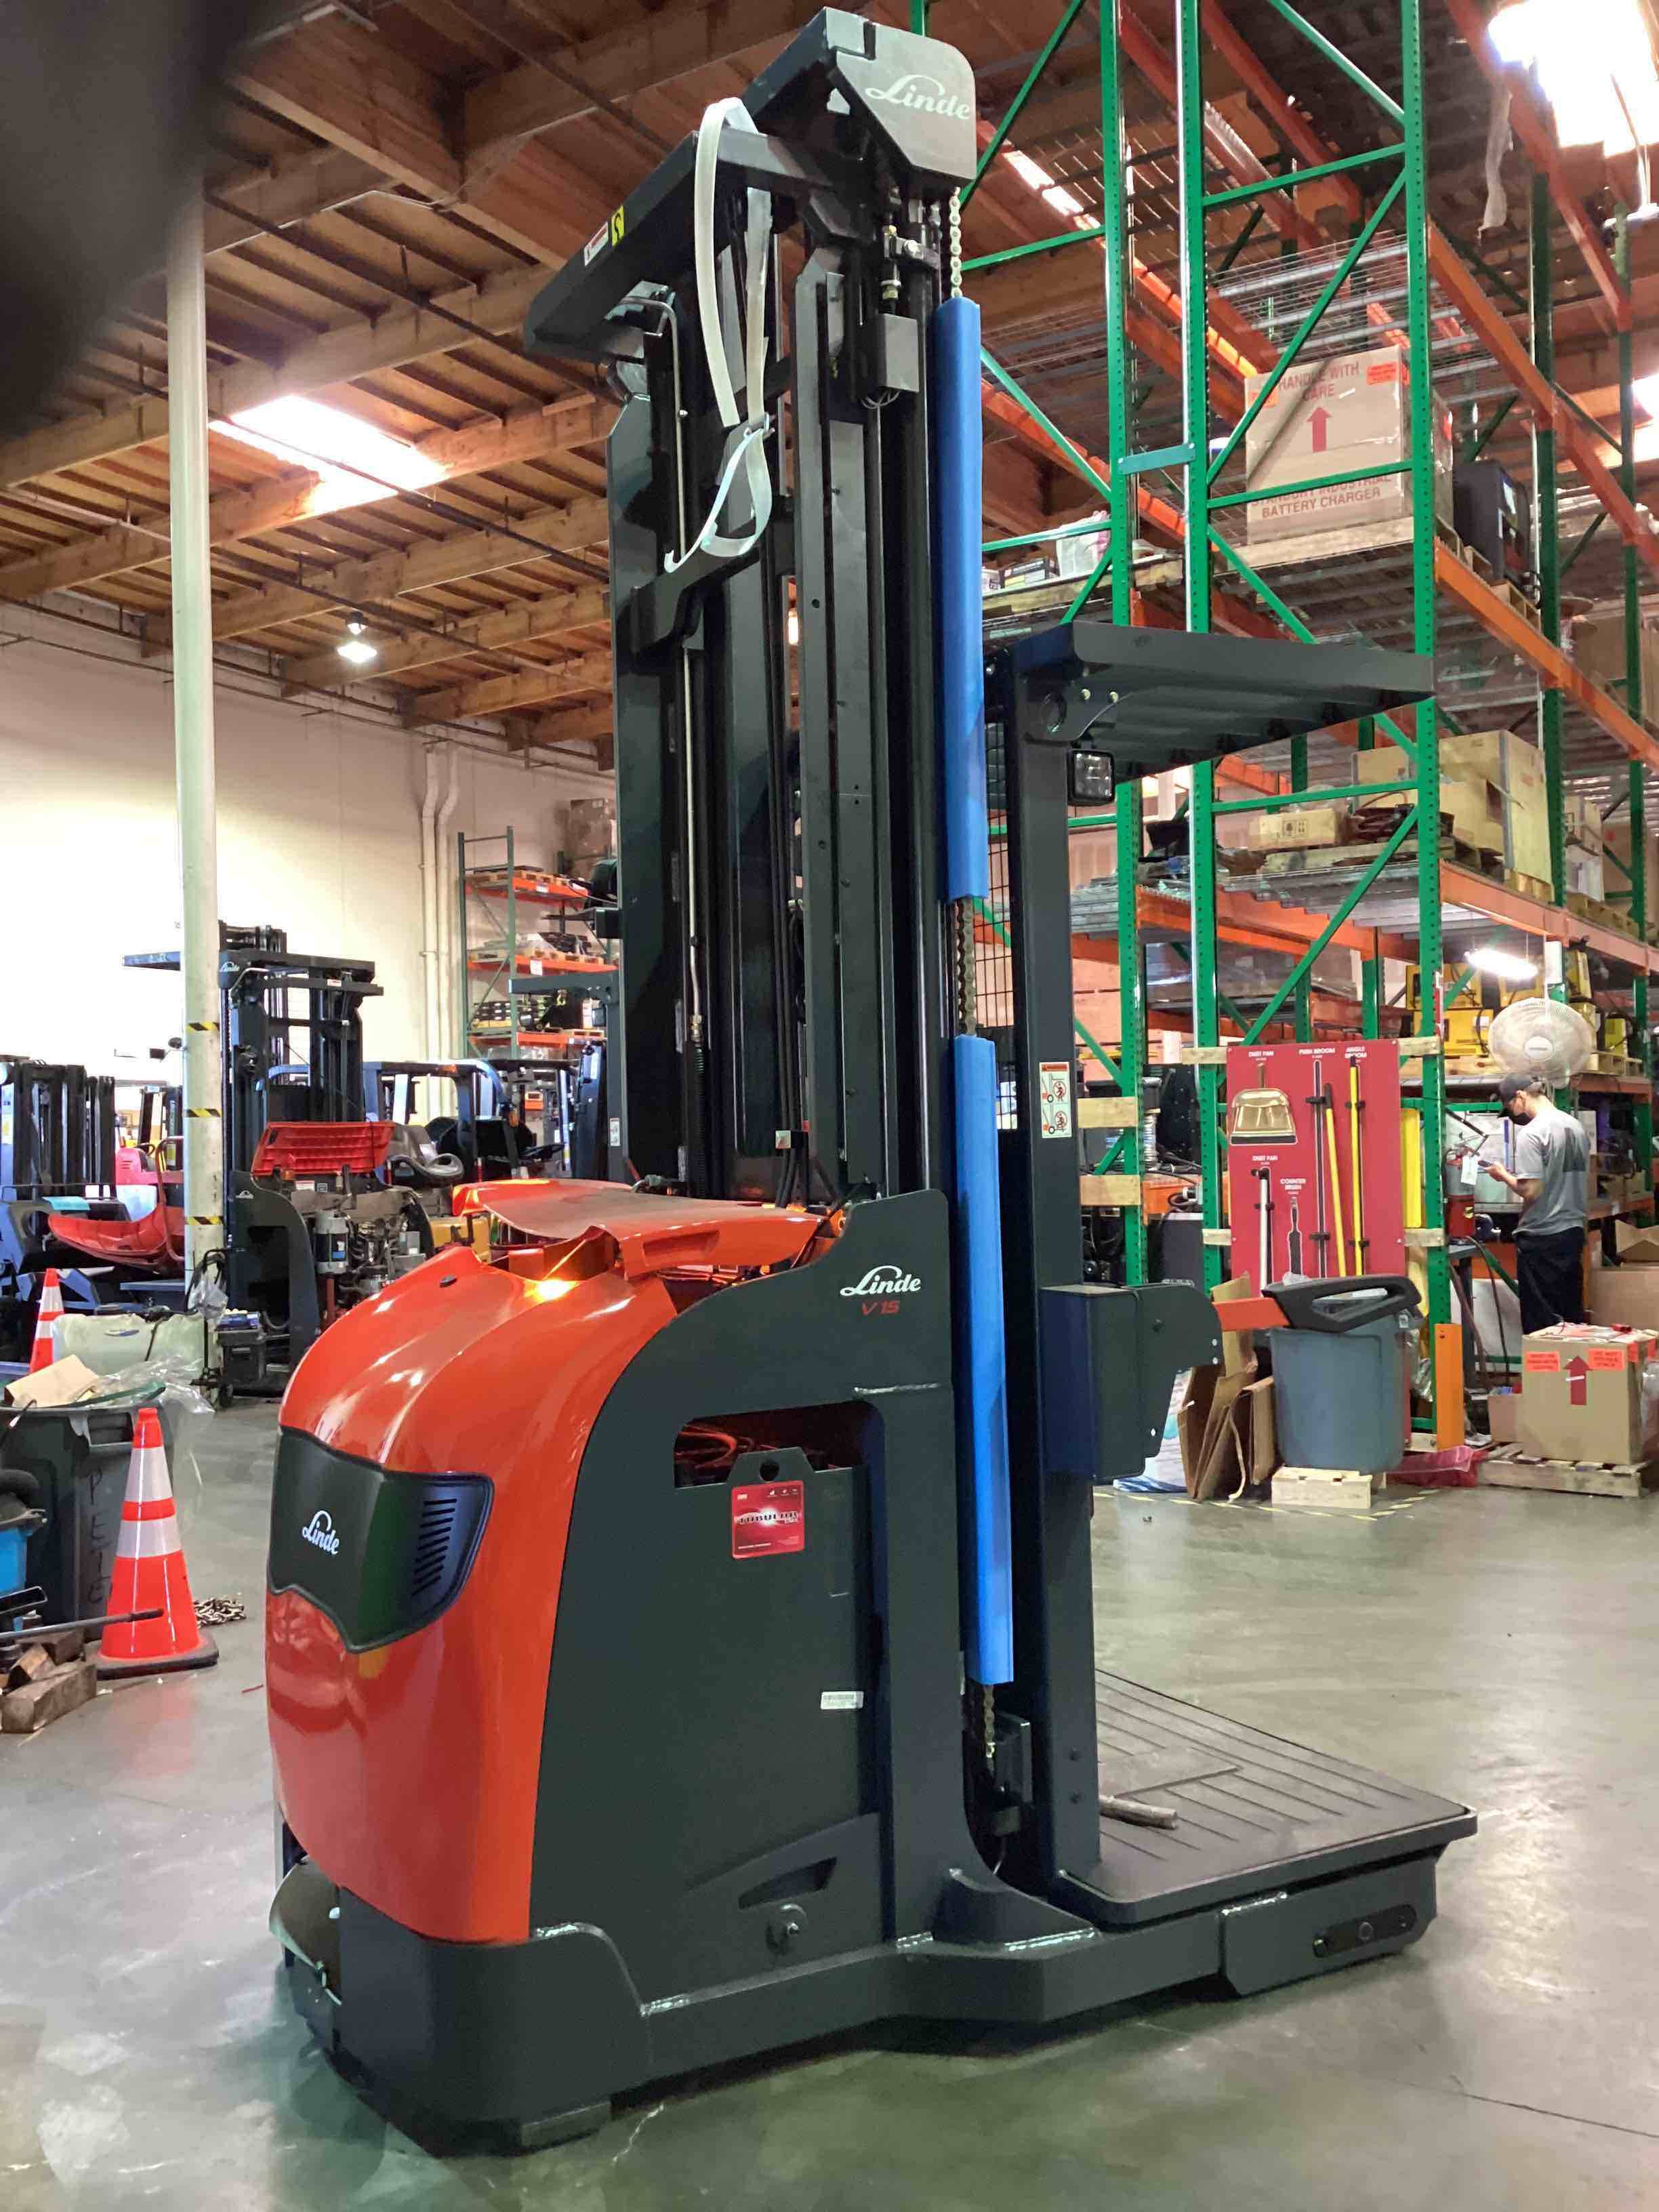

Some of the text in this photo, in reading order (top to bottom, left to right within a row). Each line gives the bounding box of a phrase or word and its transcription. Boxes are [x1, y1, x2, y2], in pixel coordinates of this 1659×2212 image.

[865, 74, 972, 120] Linde
[1279, 369, 1326, 391] HANDE
[1330, 363, 1359, 381] WITH
[1262, 487, 1380, 518] BATTERY CHARGER
[840, 1265, 922, 1296] Linde
[302, 1510, 340, 1555] Linde
